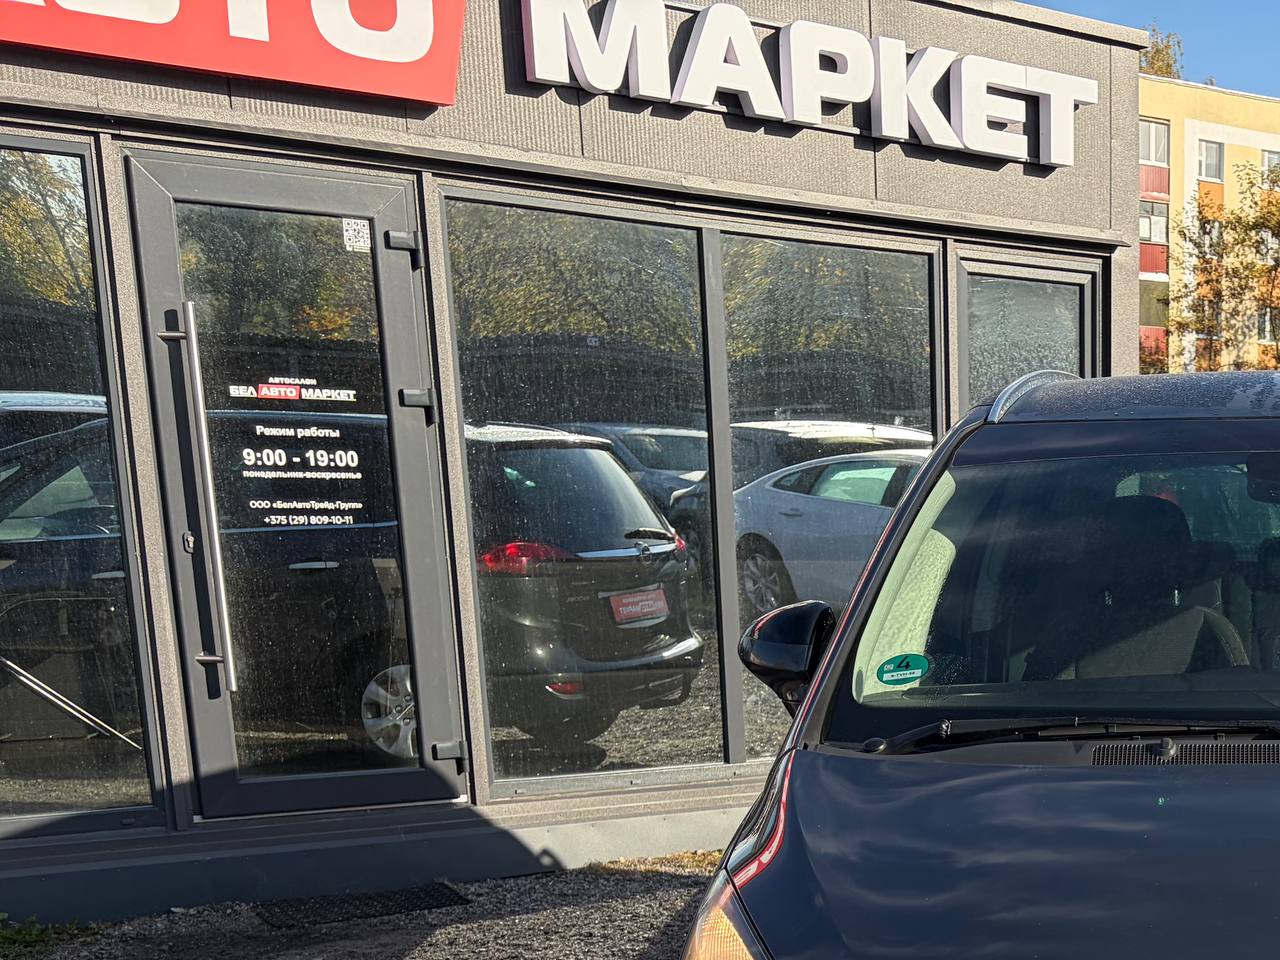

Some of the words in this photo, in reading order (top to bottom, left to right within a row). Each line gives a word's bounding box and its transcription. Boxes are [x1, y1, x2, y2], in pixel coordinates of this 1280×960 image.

[524, 0, 1098, 167] МАРКЕТ
[268, 377, 317, 385] АВТОСАЛОН
[256, 425, 295, 437] Режим
[297, 427, 340, 439] работы
[242, 448, 287, 466] 9:00
[305, 449, 359, 468] 19:00
[249, 500, 271, 509] ООО
[263, 515, 287, 525] +375
[288, 515, 308, 526] (29)
[309, 515, 354, 526] 809-10-11
[896, 656, 911, 669] 4
